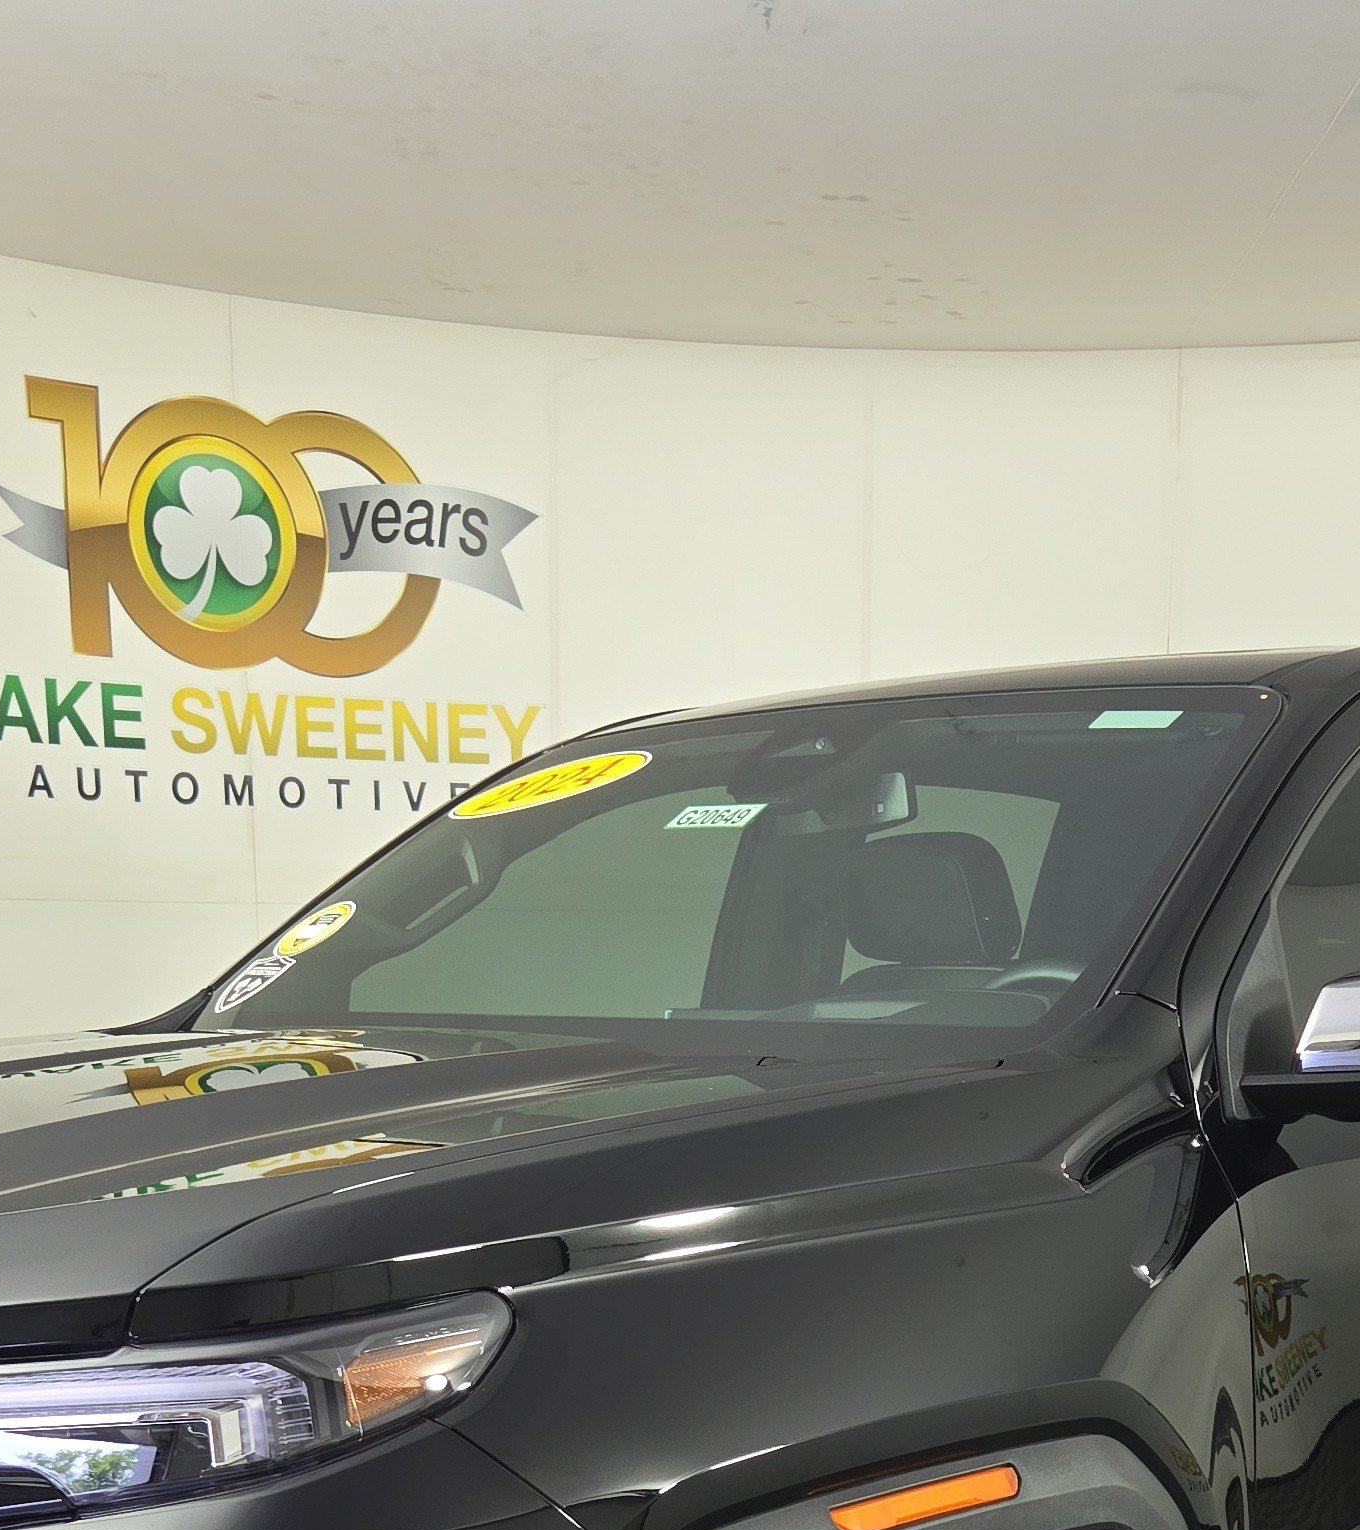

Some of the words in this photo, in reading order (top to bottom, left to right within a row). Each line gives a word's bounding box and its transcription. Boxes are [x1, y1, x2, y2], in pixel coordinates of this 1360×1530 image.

[24, 374, 442, 678] 100
[339, 496, 490, 561] years
[170, 687, 542, 766] SWEENEY
[475, 757, 626, 812] 2024
[676, 808, 751, 827] G20649
